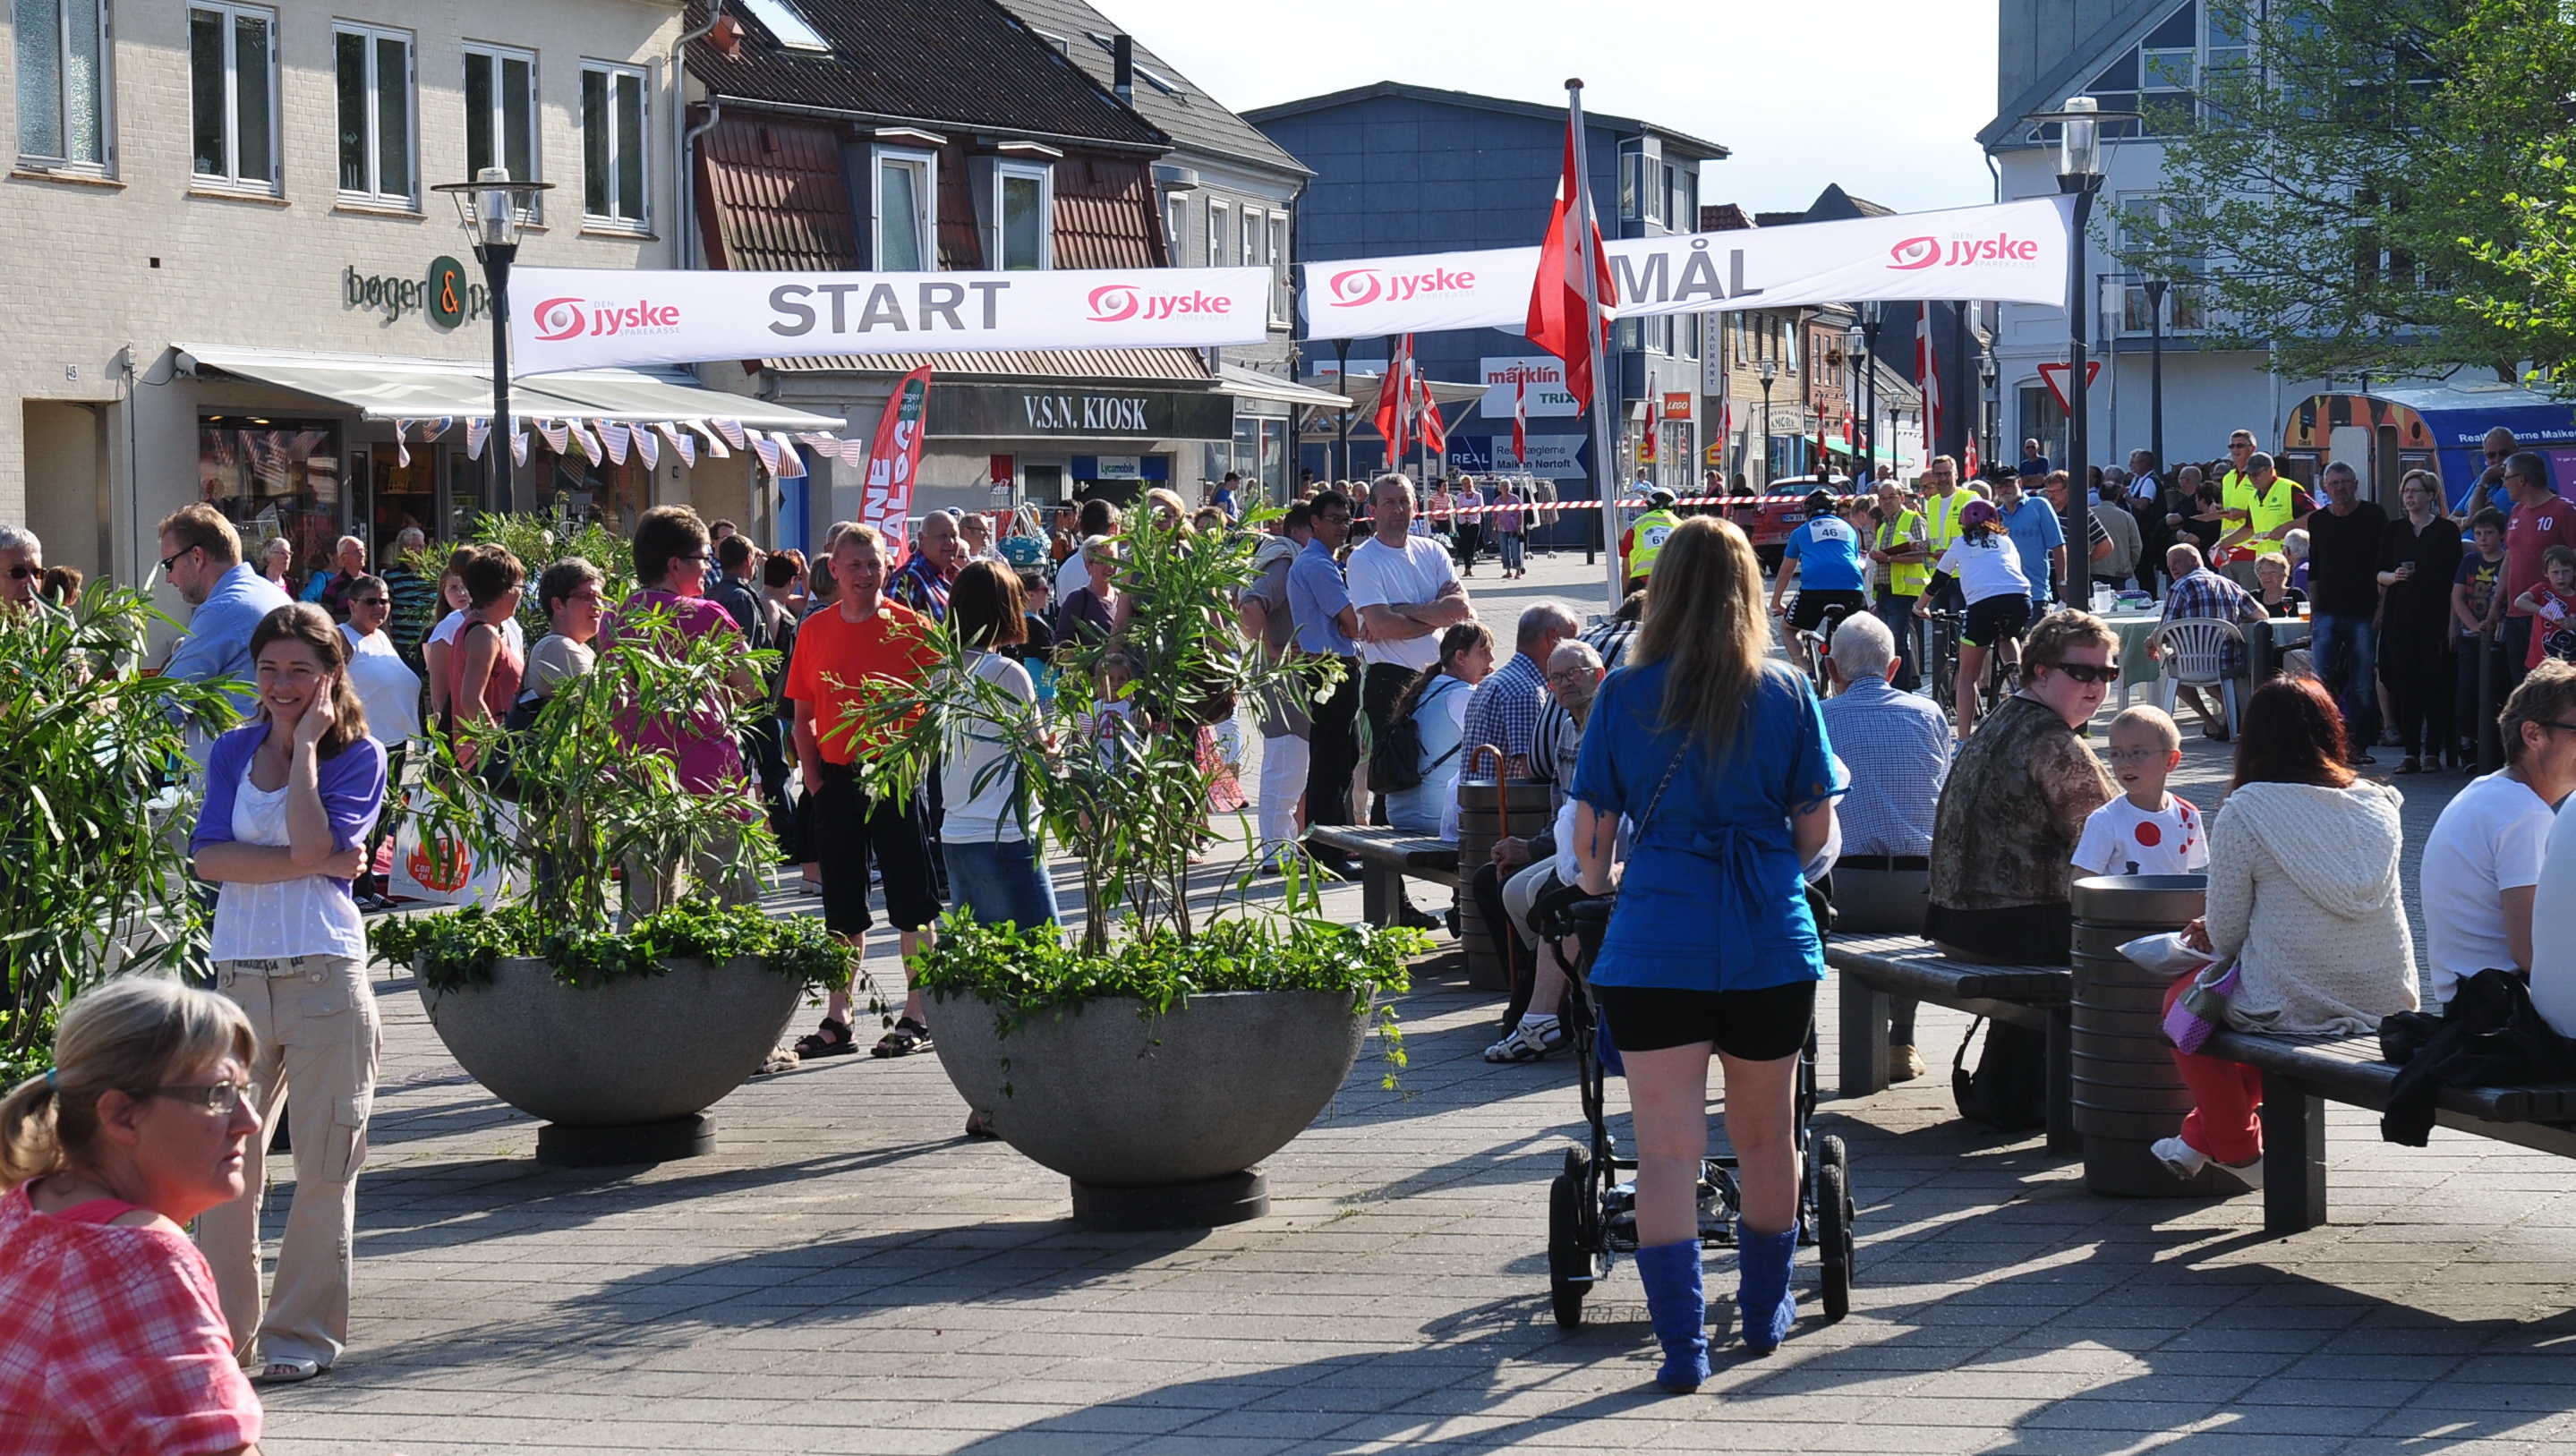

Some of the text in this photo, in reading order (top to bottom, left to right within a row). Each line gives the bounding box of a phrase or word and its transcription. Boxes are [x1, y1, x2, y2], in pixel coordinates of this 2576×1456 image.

[1944, 233, 2038, 266] jyske
[1608, 238, 1764, 304] MÅL
[1974, 260, 2036, 268] SPAREKASSE
[1386, 268, 1475, 302] jyske
[348, 265, 427, 322] bøger
[441, 270, 459, 313] &
[768, 281, 1011, 336] START
[1142, 290, 1232, 319] jyske
[591, 300, 679, 336] jyske
[618, 327, 680, 336] SPAREKASSE
[1709, 311, 1717, 386] STAURANT
[1488, 366, 1560, 384] mäklin
[1539, 393, 1576, 404] TRIX
[1667, 401, 1689, 410] LEGO
[1023, 396, 1148, 430] V.S.N. KIOSK
[2540, 430, 2576, 439] Maike
[1497, 446, 1565, 457] Reaæglerne
[1452, 454, 1489, 464] REAL
[1535, 459, 1571, 469] Nørtoft
[1100, 462, 1135, 475] Lycamobile
[2537, 516, 2554, 531] 10
[1821, 528, 1838, 537] 46
[1981, 539, 2000, 549] 43
